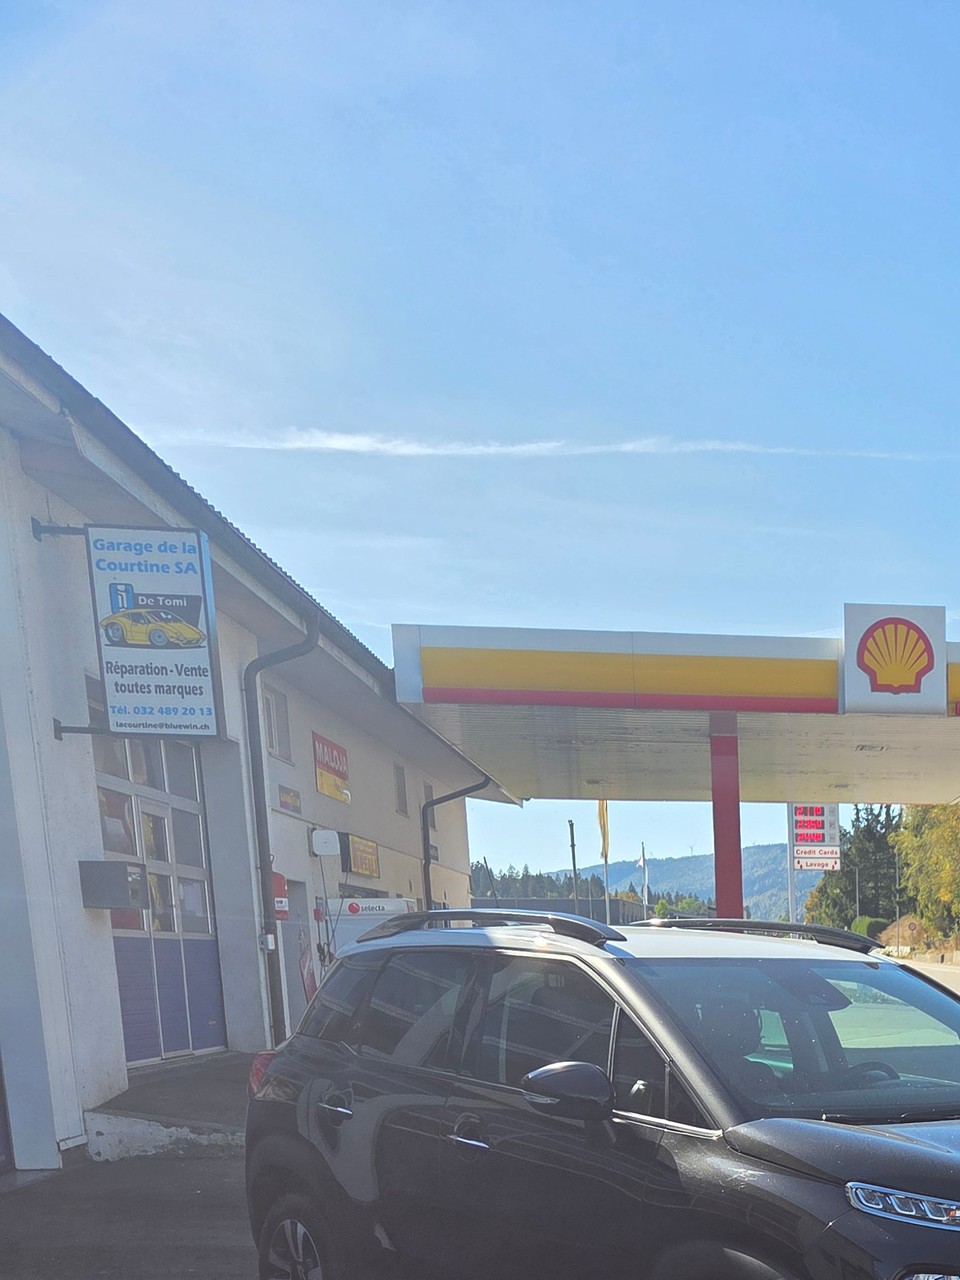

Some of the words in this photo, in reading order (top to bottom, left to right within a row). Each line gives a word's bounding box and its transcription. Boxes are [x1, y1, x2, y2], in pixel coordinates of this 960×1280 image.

[93, 538, 153, 556] Garage
[157, 541, 178, 553] de
[182, 541, 197, 554] la
[95, 558, 170, 574] Courtine
[174, 561, 198, 575] SA
[157, 596, 187, 607] Tomi
[105, 660, 168, 678] Réparation
[174, 663, 209, 678] Vente
[114, 681, 152, 694] toutes
[154, 684, 204, 699] marques
[110, 705, 130, 715] Tél.
[133, 706, 155, 715] 032
[157, 706, 179, 715] 489
[181, 707, 196, 716] 20
[199, 707, 213, 716] 13
[116, 721, 210, 730] lacourtine@bluewin.ch
[315, 740, 348, 774] MALOJA
[361, 904, 385, 912] selecta
